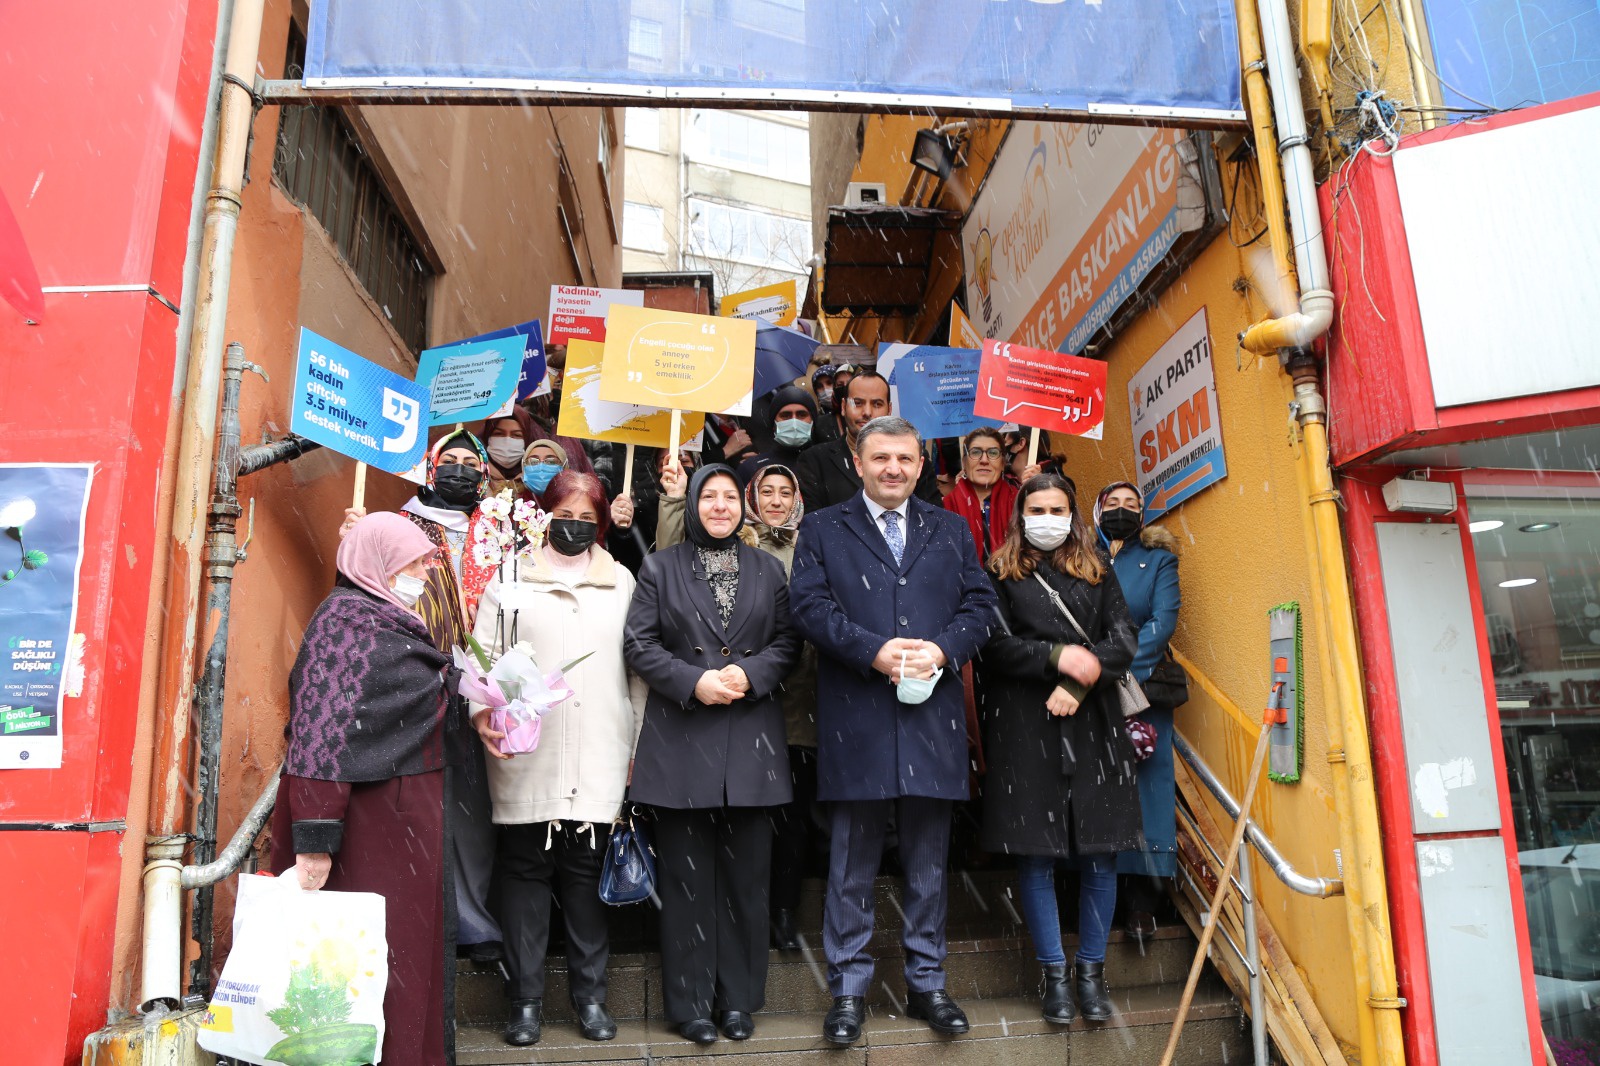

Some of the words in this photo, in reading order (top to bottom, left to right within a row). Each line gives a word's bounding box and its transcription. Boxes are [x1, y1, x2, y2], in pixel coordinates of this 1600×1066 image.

[1001, 186, 1034, 268] gençlik
[1013, 214, 1049, 283] kolları
[558, 285, 602, 298] Kadınlar,
[557, 297, 591, 306] siyasetin
[556, 307, 586, 315] nesnesi
[1068, 286, 1119, 352] GÜMÜŞHANE
[1120, 271, 1130, 296] İL
[555, 316, 575, 324] değil
[554, 325, 592, 335] öznesidir.
[639, 337, 667, 349] Engelli
[667, 341, 696, 352] çocuğu
[697, 344, 715, 353] olan
[661, 350, 691, 360] anneye
[310, 349, 327, 368] 56
[329, 359, 349, 379] bin
[655, 359, 661, 367] 5
[662, 360, 672, 369] yıl
[673, 362, 697, 371] erken
[308, 363, 344, 390] kadın
[656, 370, 695, 381] emeklilik.
[1006, 375, 1044, 388] Desteklerden
[1044, 384, 1075, 394] yararlanan
[1146, 374, 1164, 408] AK
[306, 381, 347, 407] çiftçiye
[473, 389, 492, 399] %49
[1065, 394, 1085, 405] %41
[306, 393, 325, 411] 3.5
[328, 404, 368, 429] milyar
[304, 410, 342, 434] destek
[343, 427, 380, 451] verdik.
[1139, 385, 1211, 474] SKM
[19, 639, 36, 648] BİR
[38, 640, 52, 648] DE
[11, 649, 56, 660] SAĞLIKLI
[6, 710, 28, 720] ÖDÜL
[9, 722, 14, 731] 1
[15, 721, 41, 730] MİLYON
[231, 992, 256, 1005] ELİNDE!
